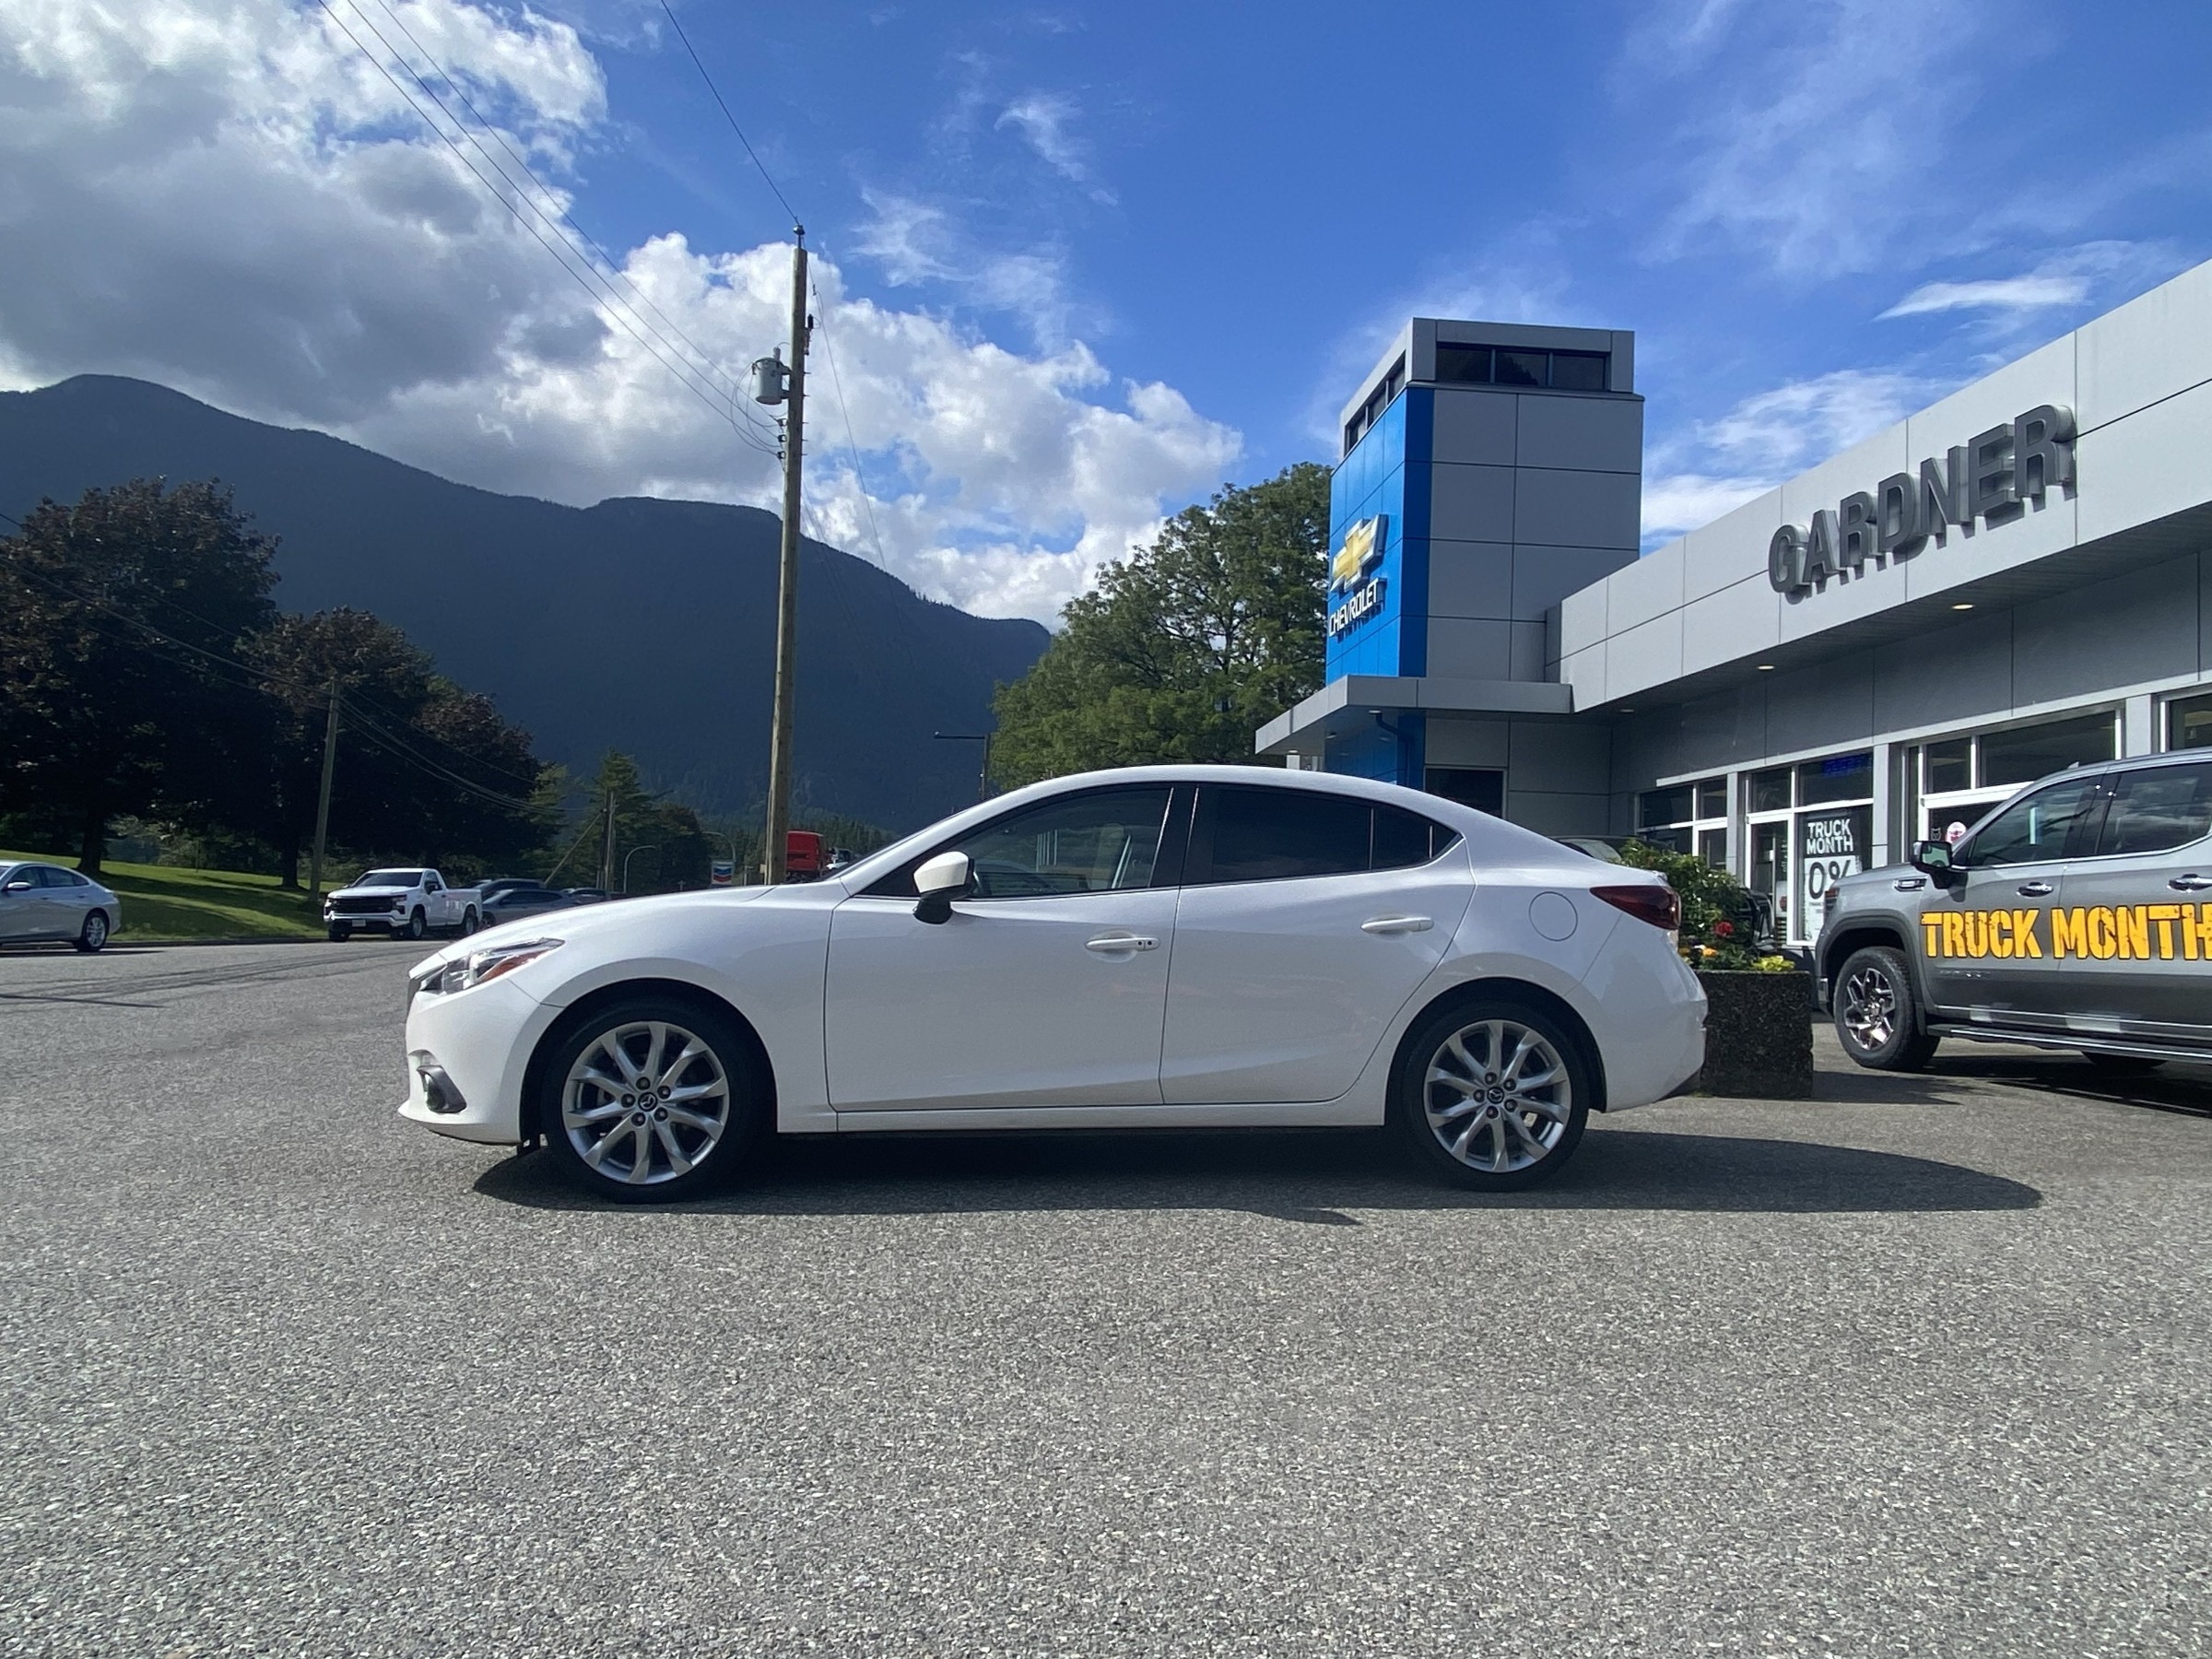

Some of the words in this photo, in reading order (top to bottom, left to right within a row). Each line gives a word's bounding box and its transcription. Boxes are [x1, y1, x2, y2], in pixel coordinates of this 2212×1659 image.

[1769, 404, 2070, 593] GARDNER
[1329, 577, 1382, 637] CHEVROLET
[1806, 835, 1854, 854] MONTH
[1807, 818, 1852, 840] TRUCK
[1921, 908, 2042, 959] TRUCK
[2051, 902, 2212, 960] MONTH
